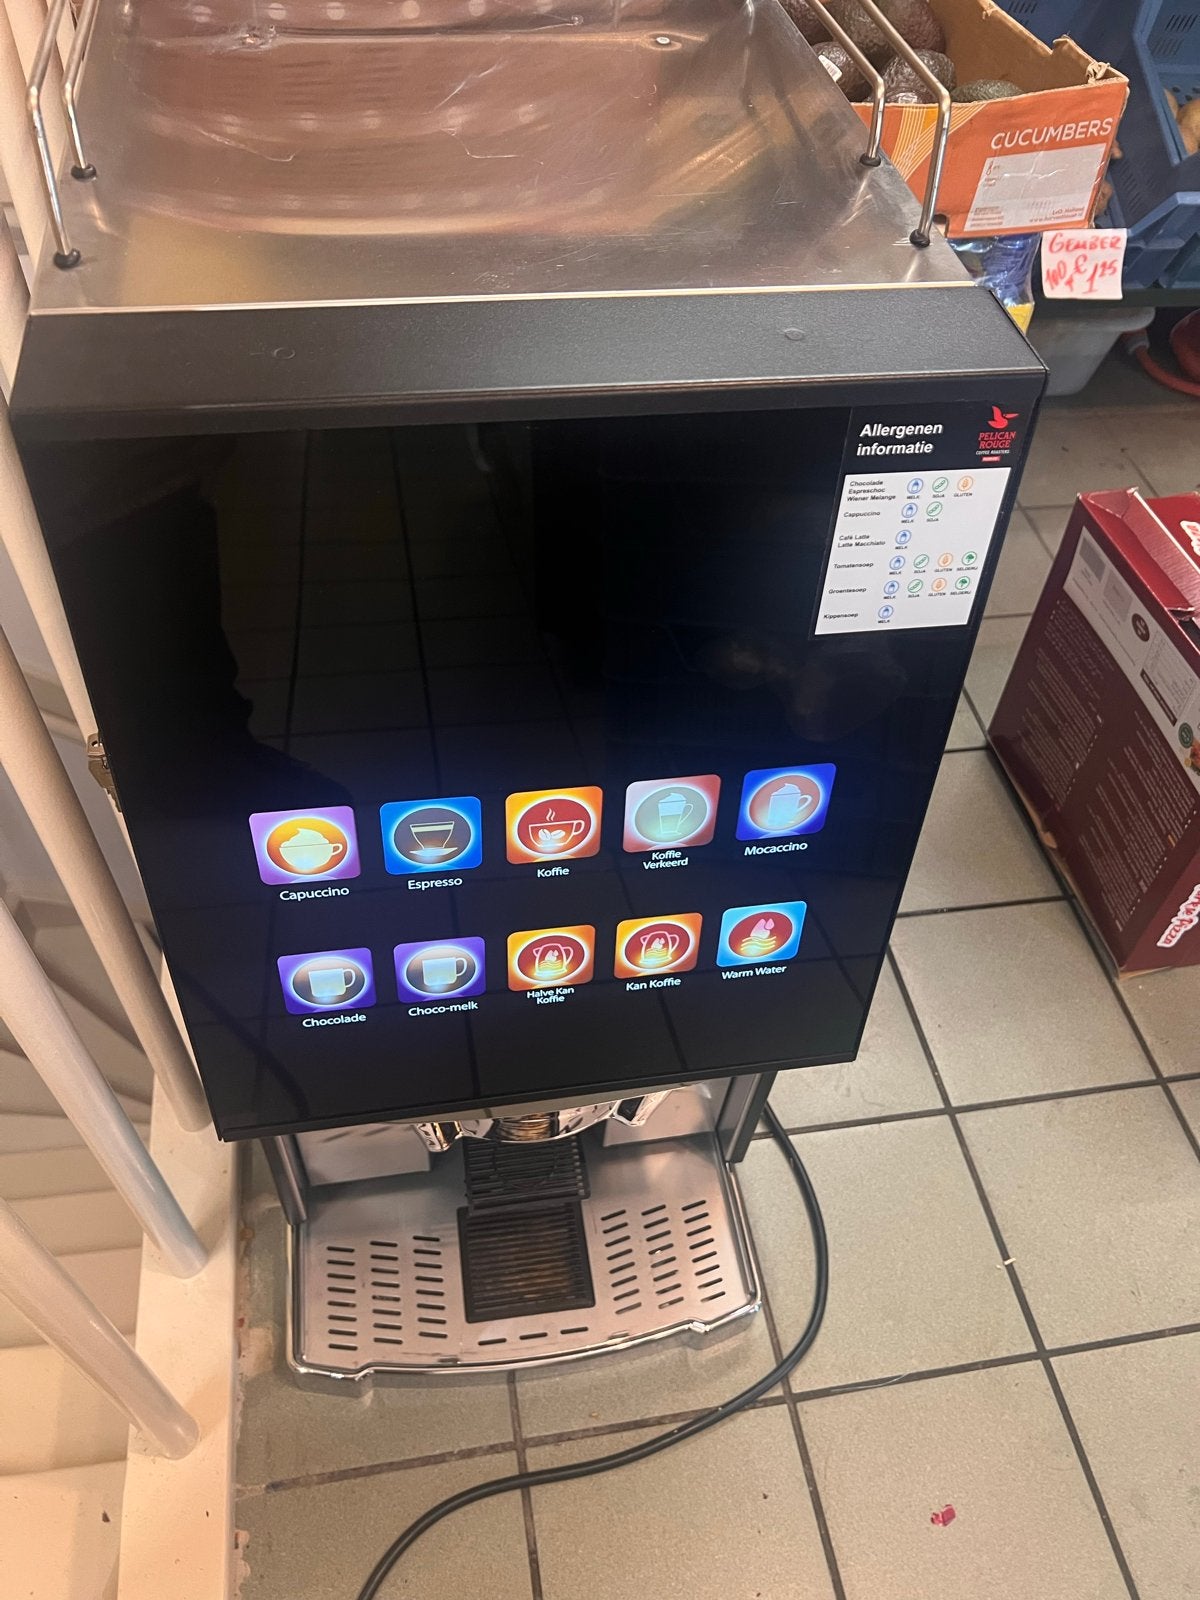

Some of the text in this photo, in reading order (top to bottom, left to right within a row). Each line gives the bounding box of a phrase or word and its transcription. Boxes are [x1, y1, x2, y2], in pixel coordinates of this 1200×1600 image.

[990, 117, 1113, 150] CUCUMBERS
[1048, 232, 1122, 254] GEMBER
[859, 423, 943, 439] Allergenen
[978, 431, 1017, 441] PELICAN
[856, 441, 934, 456] informatie
[979, 440, 1012, 449] ROUGE
[651, 850, 682, 861] Koffie
[744, 841, 808, 856] Mocaccino
[643, 857, 689, 870] Verkeerd
[537, 866, 570, 878] Koffie
[407, 876, 463, 891] Espresso
[279, 886, 350, 902] Capuccino
[721, 965, 787, 980] Warm Water
[626, 977, 682, 991] Kan Koffie
[526, 986, 575, 998] Halve Kan
[536, 994, 565, 1005] Koffie
[408, 1001, 479, 1017] Choco-melk
[302, 1013, 367, 1028] Chocolade
